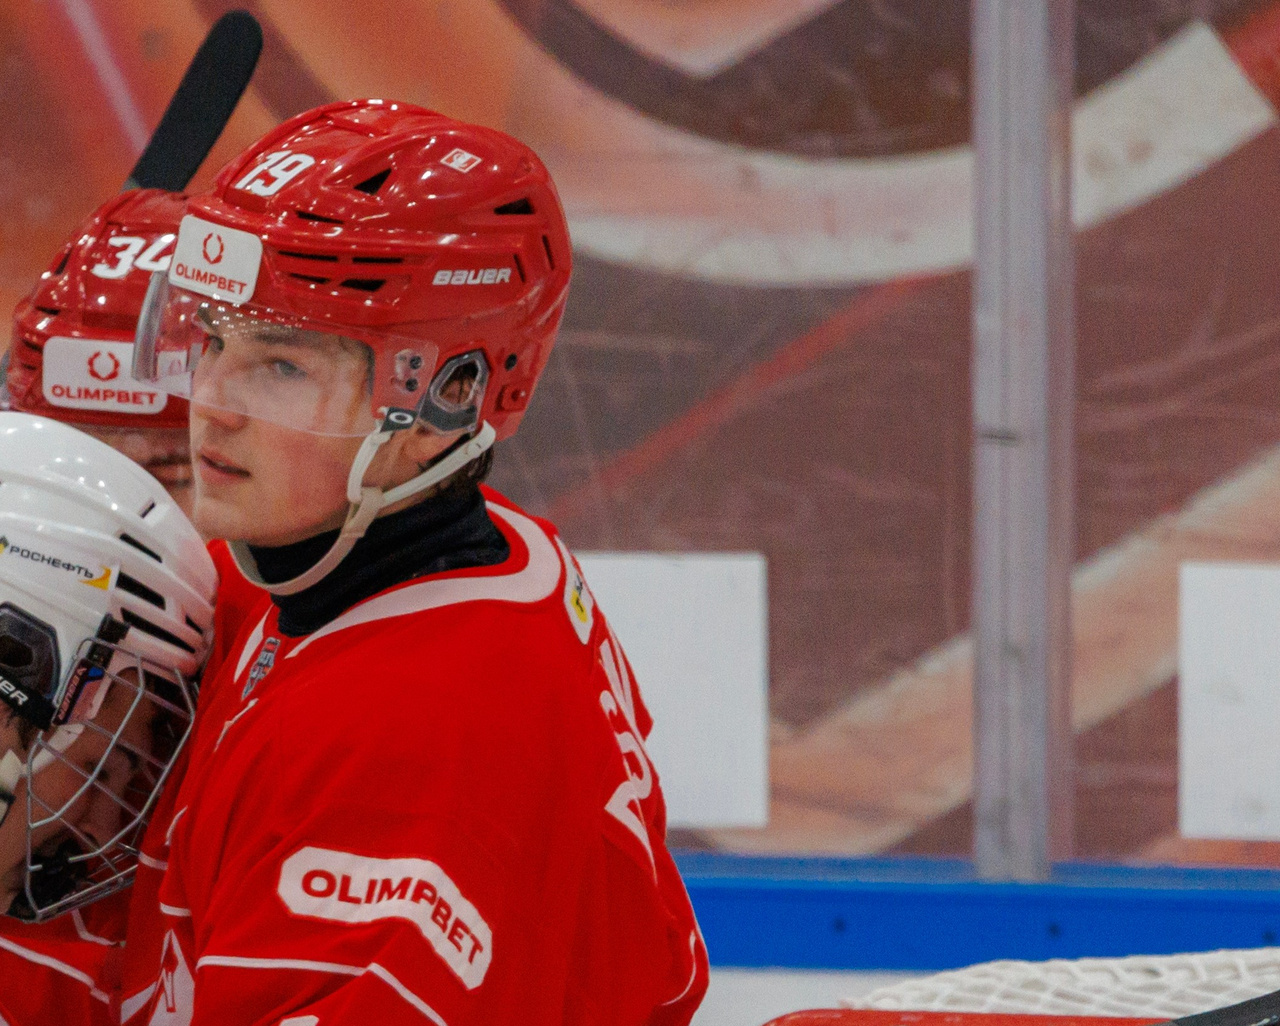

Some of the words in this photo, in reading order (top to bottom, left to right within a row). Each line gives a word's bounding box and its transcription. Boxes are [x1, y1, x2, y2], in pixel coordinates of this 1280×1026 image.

[234, 149, 316, 198] 19
[175, 262, 248, 296] OLIMPBET
[51, 384, 157, 406] OLIMPBET
[9, 544, 95, 581] РОСНЕФТЬ
[300, 867, 485, 967] OLIMPBET
